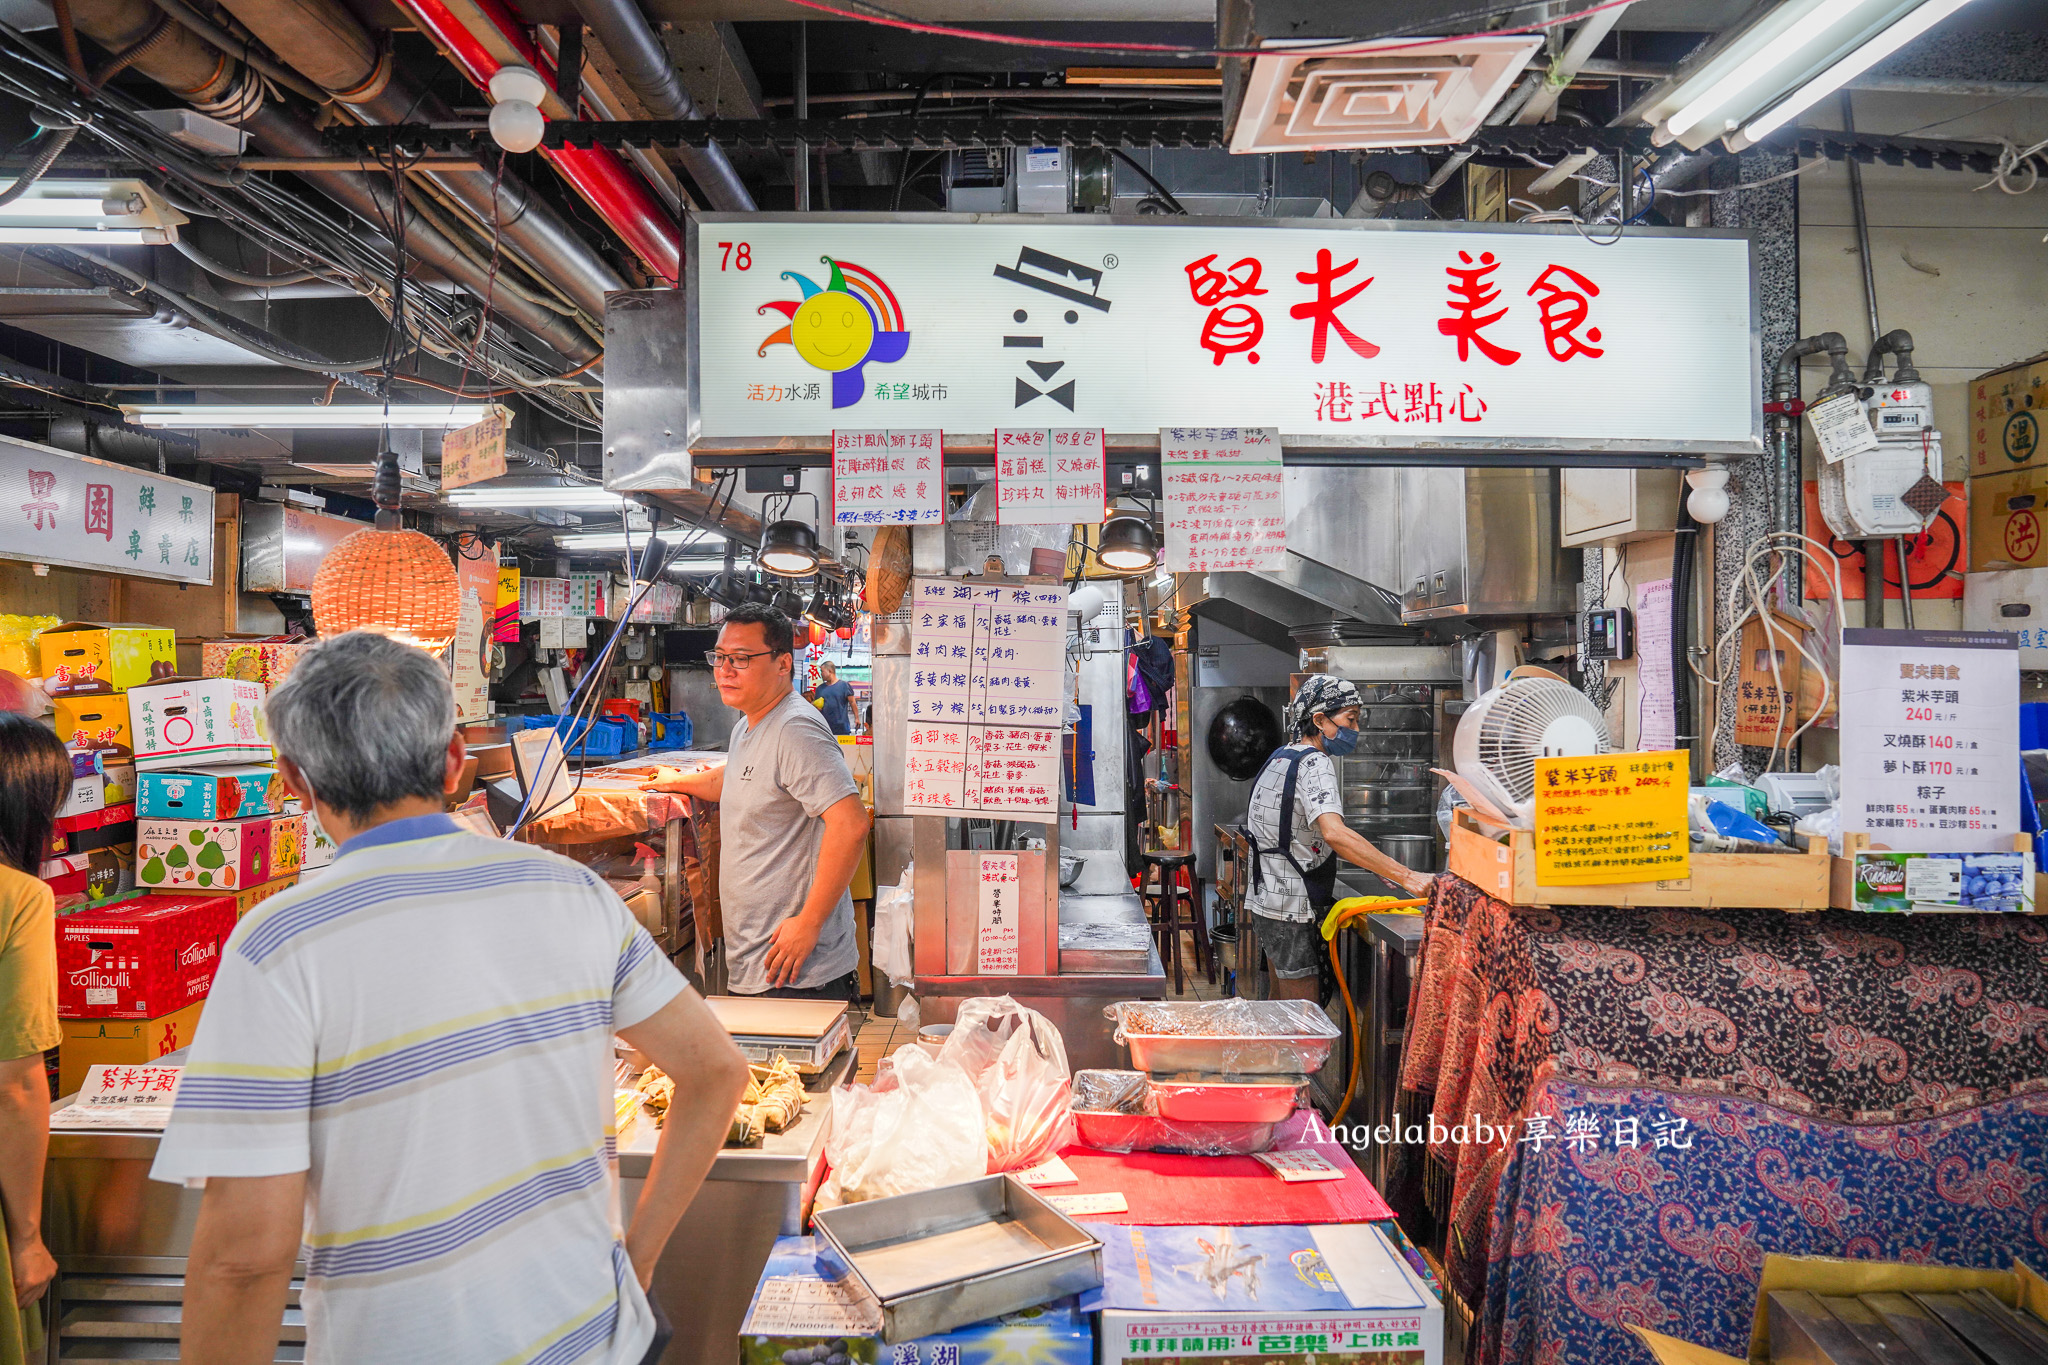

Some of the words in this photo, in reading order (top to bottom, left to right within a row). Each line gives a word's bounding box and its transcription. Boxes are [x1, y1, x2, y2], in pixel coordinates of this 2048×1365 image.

[717, 241, 752, 271] 78
[1437, 250, 1605, 366] 美食
[747, 382, 821, 402] 活力水源
[874, 382, 948, 402] 希望城市
[1313, 380, 1488, 424] 港式點心
[890, 433, 933, 450] 獅子頭
[1002, 432, 1045, 446] 叉燒包
[1055, 431, 1096, 446] 奶皇包
[1170, 428, 1238, 443] 紫米芋頭
[1057, 457, 1101, 474] 叉燒酥
[1001, 486, 1045, 502] 珍珠丸
[1056, 482, 1103, 500] 梅汁排骨
[20, 468, 114, 543] 果園
[139, 485, 194, 525] 鮮果
[2009, 515, 2035, 554] 洪
[125, 530, 200, 568] 專賣店
[921, 613, 966, 629] 全家福
[916, 642, 967, 659] 鮮肉粽
[55, 662, 97, 682] 富坤
[914, 671, 967, 687] 蛋黃肉粽
[1899, 663, 1961, 680] 賢夫美食
[1901, 690, 1959, 704] 紫米芋頭
[912, 700, 965, 716] 豆沙粽
[1906, 707, 1933, 721] 240
[142, 701, 157, 751] 風味獨特
[202, 696, 215, 743] 口齒留香
[72, 727, 117, 747] 富坤
[910, 729, 960, 745] 南部粽
[1883, 734, 1926, 748] 叉燒酥
[1928, 736, 1953, 749] 140
[1545, 766, 1618, 787] 紫米芋頭
[1929, 762, 1952, 775] 170
[1917, 786, 1946, 800] 粽子
[1866, 804, 1895, 814] 鮮肉粽
[1896, 804, 1909, 814] 55
[1969, 806, 1981, 815] 65
[1866, 818, 1904, 828] 全家福粽
[1906, 819, 1918, 828] 75
[1939, 819, 1967, 829] 豆沙粽
[1969, 820, 1981, 829] 55
[181, 942, 216, 966] collipulli
[70, 972, 130, 989] collipulli
[187, 981, 210, 997] APPLES
[99, 1024, 106, 1038] A
[133, 1025, 141, 1038] 斤
[100, 1066, 180, 1093] 紫米芋頭
